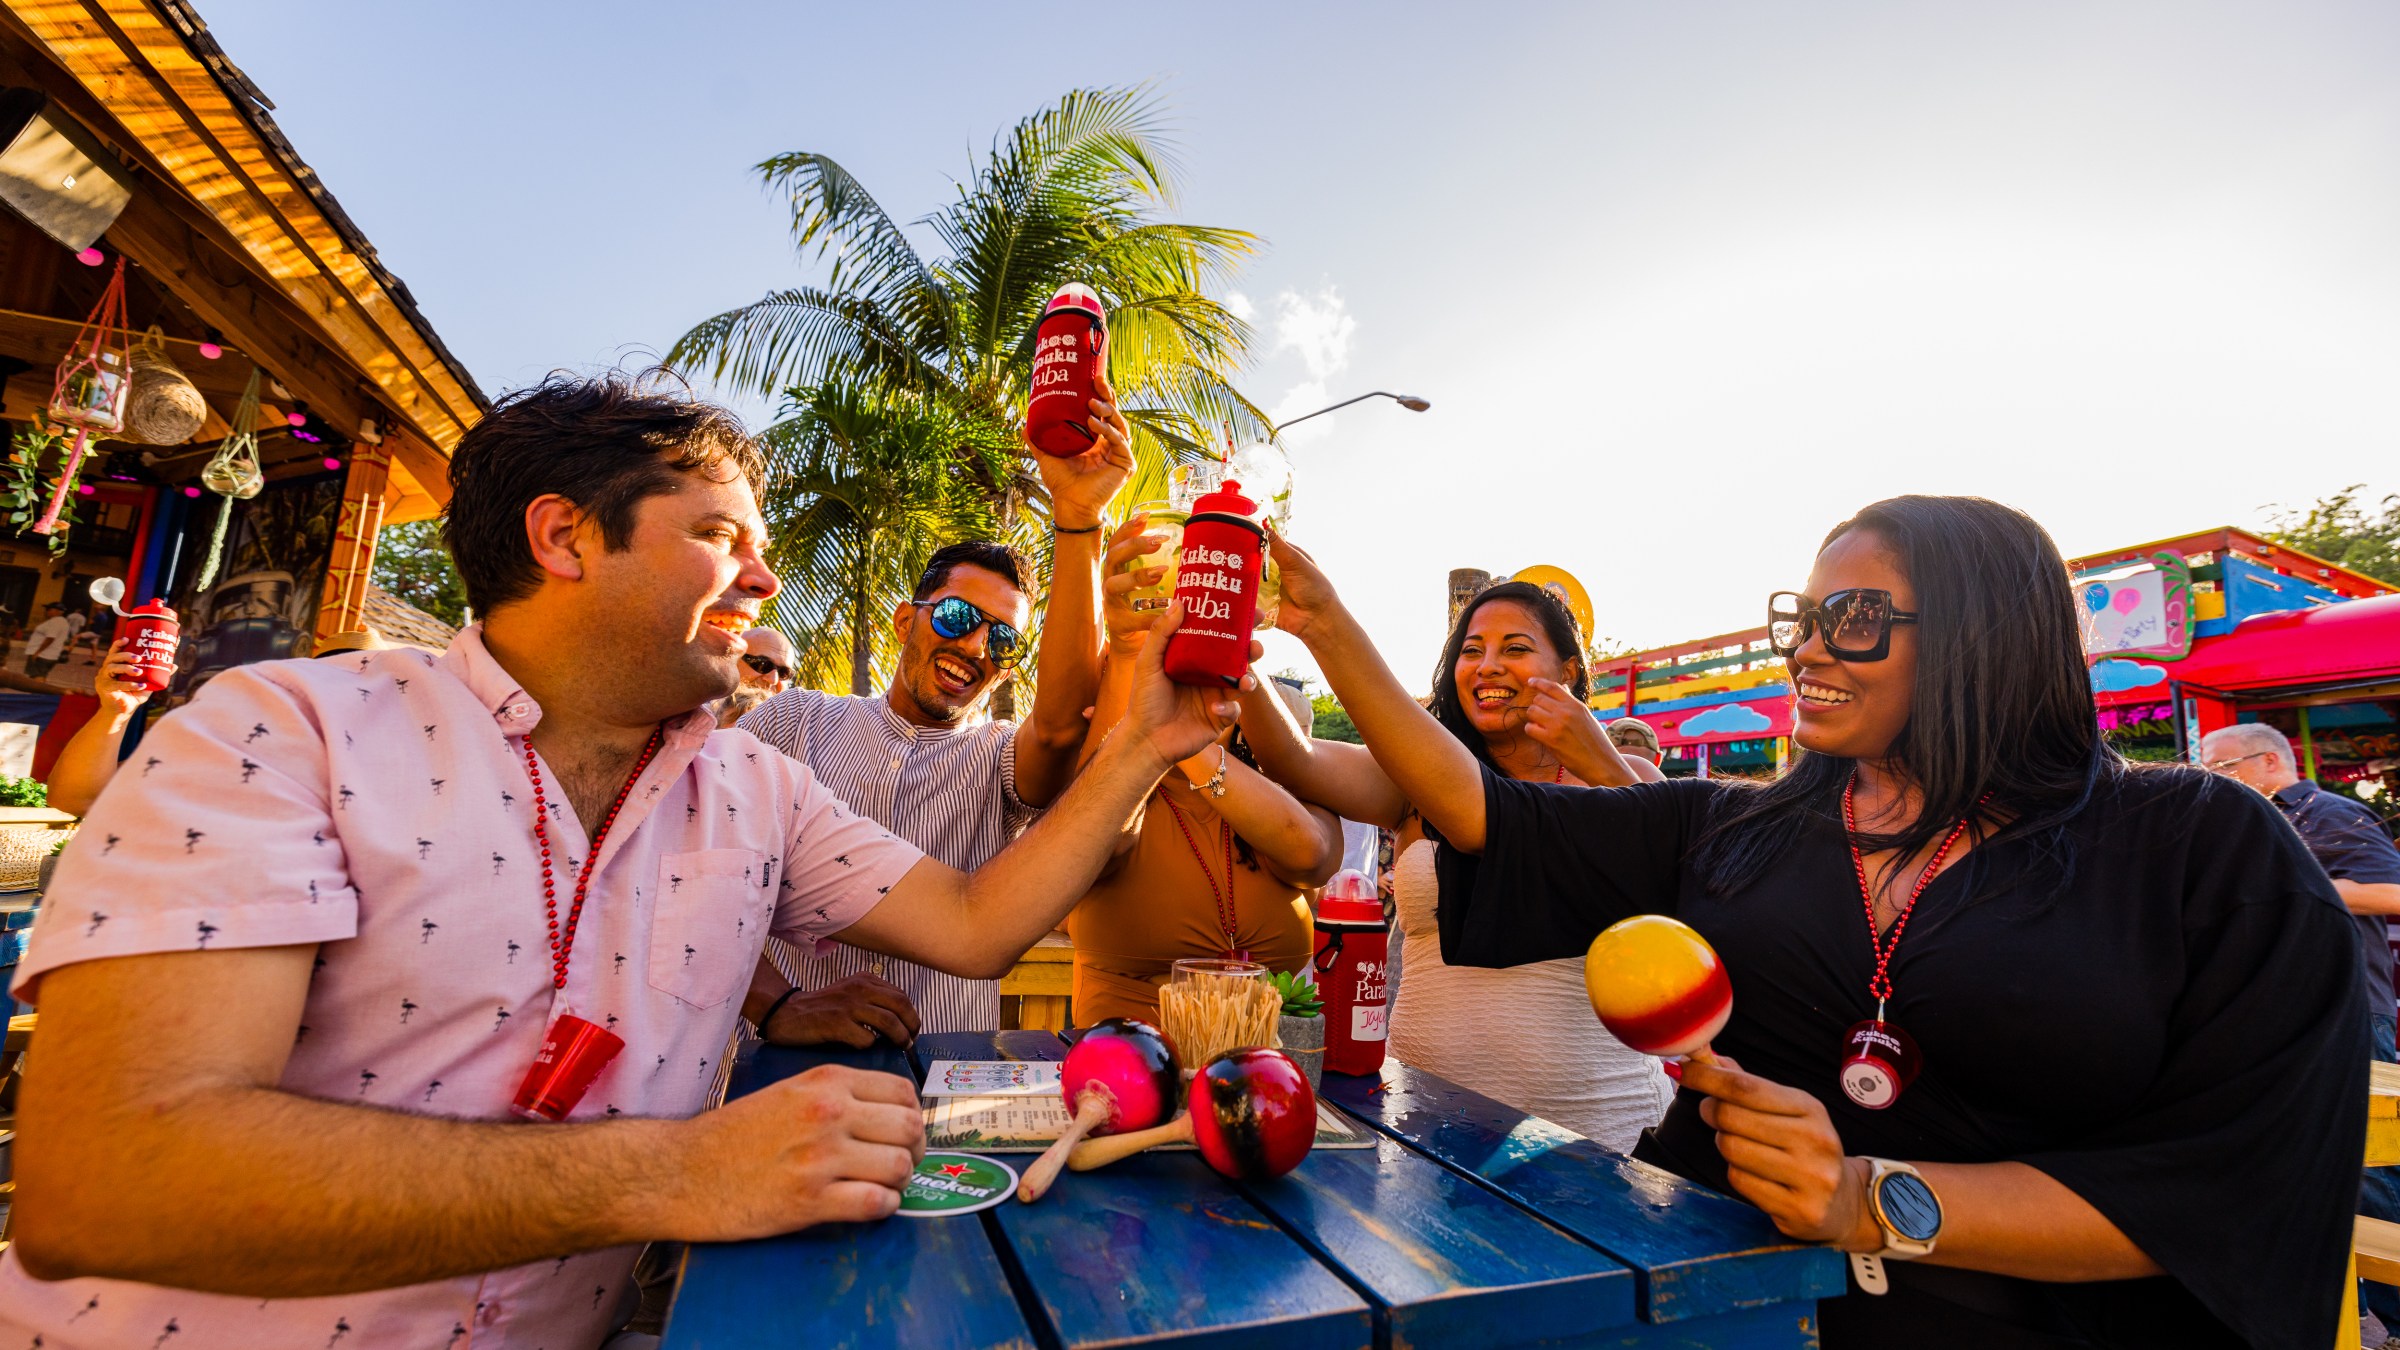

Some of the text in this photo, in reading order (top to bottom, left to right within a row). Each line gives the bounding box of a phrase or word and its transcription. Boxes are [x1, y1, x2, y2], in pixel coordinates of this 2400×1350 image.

[1035, 334, 1077, 358] ukoo
[1032, 348, 1078, 376] unuku
[1031, 365, 1069, 394] ruba
[1180, 544, 1243, 570] Kukoo
[1177, 591, 1230, 620] ruba
[911, 1173, 989, 1198] ineken
